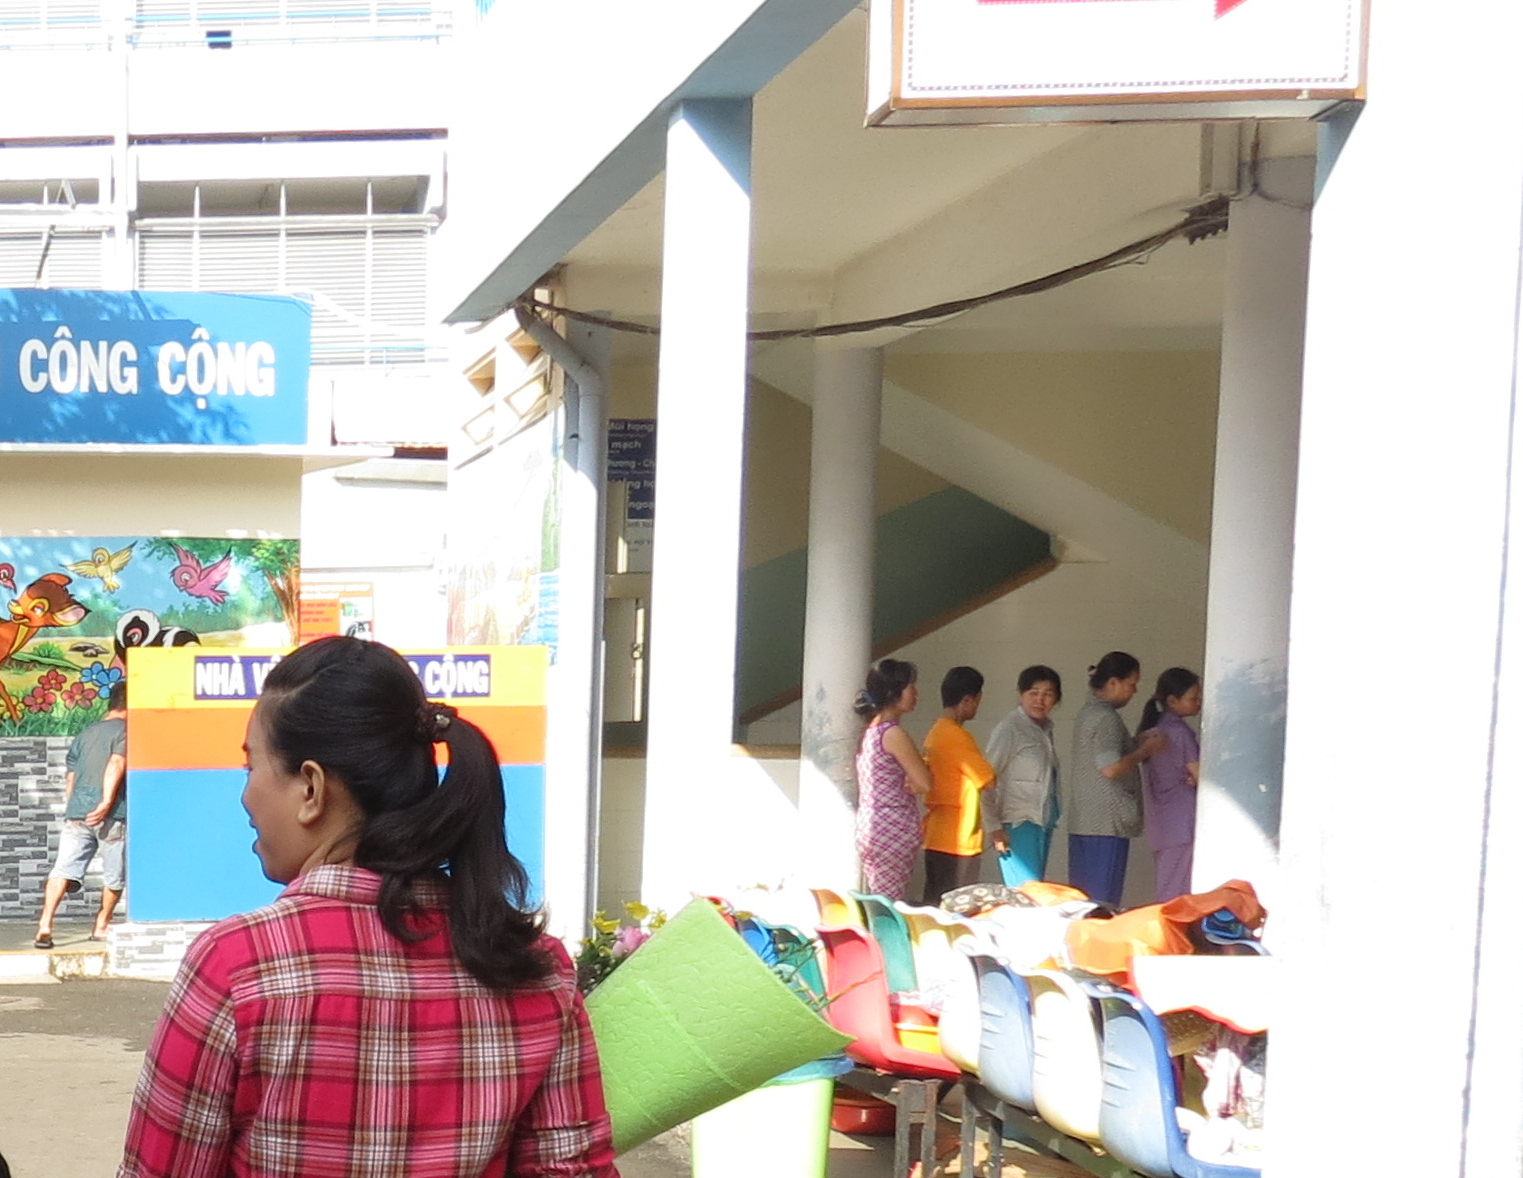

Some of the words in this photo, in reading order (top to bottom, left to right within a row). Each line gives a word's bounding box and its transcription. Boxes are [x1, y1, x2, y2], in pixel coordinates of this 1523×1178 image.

[19, 326, 140, 396] CÔNG
[157, 327, 277, 410] CỘNG
[196, 654, 246, 696] NHÀ
[425, 653, 489, 699] CỘNG
